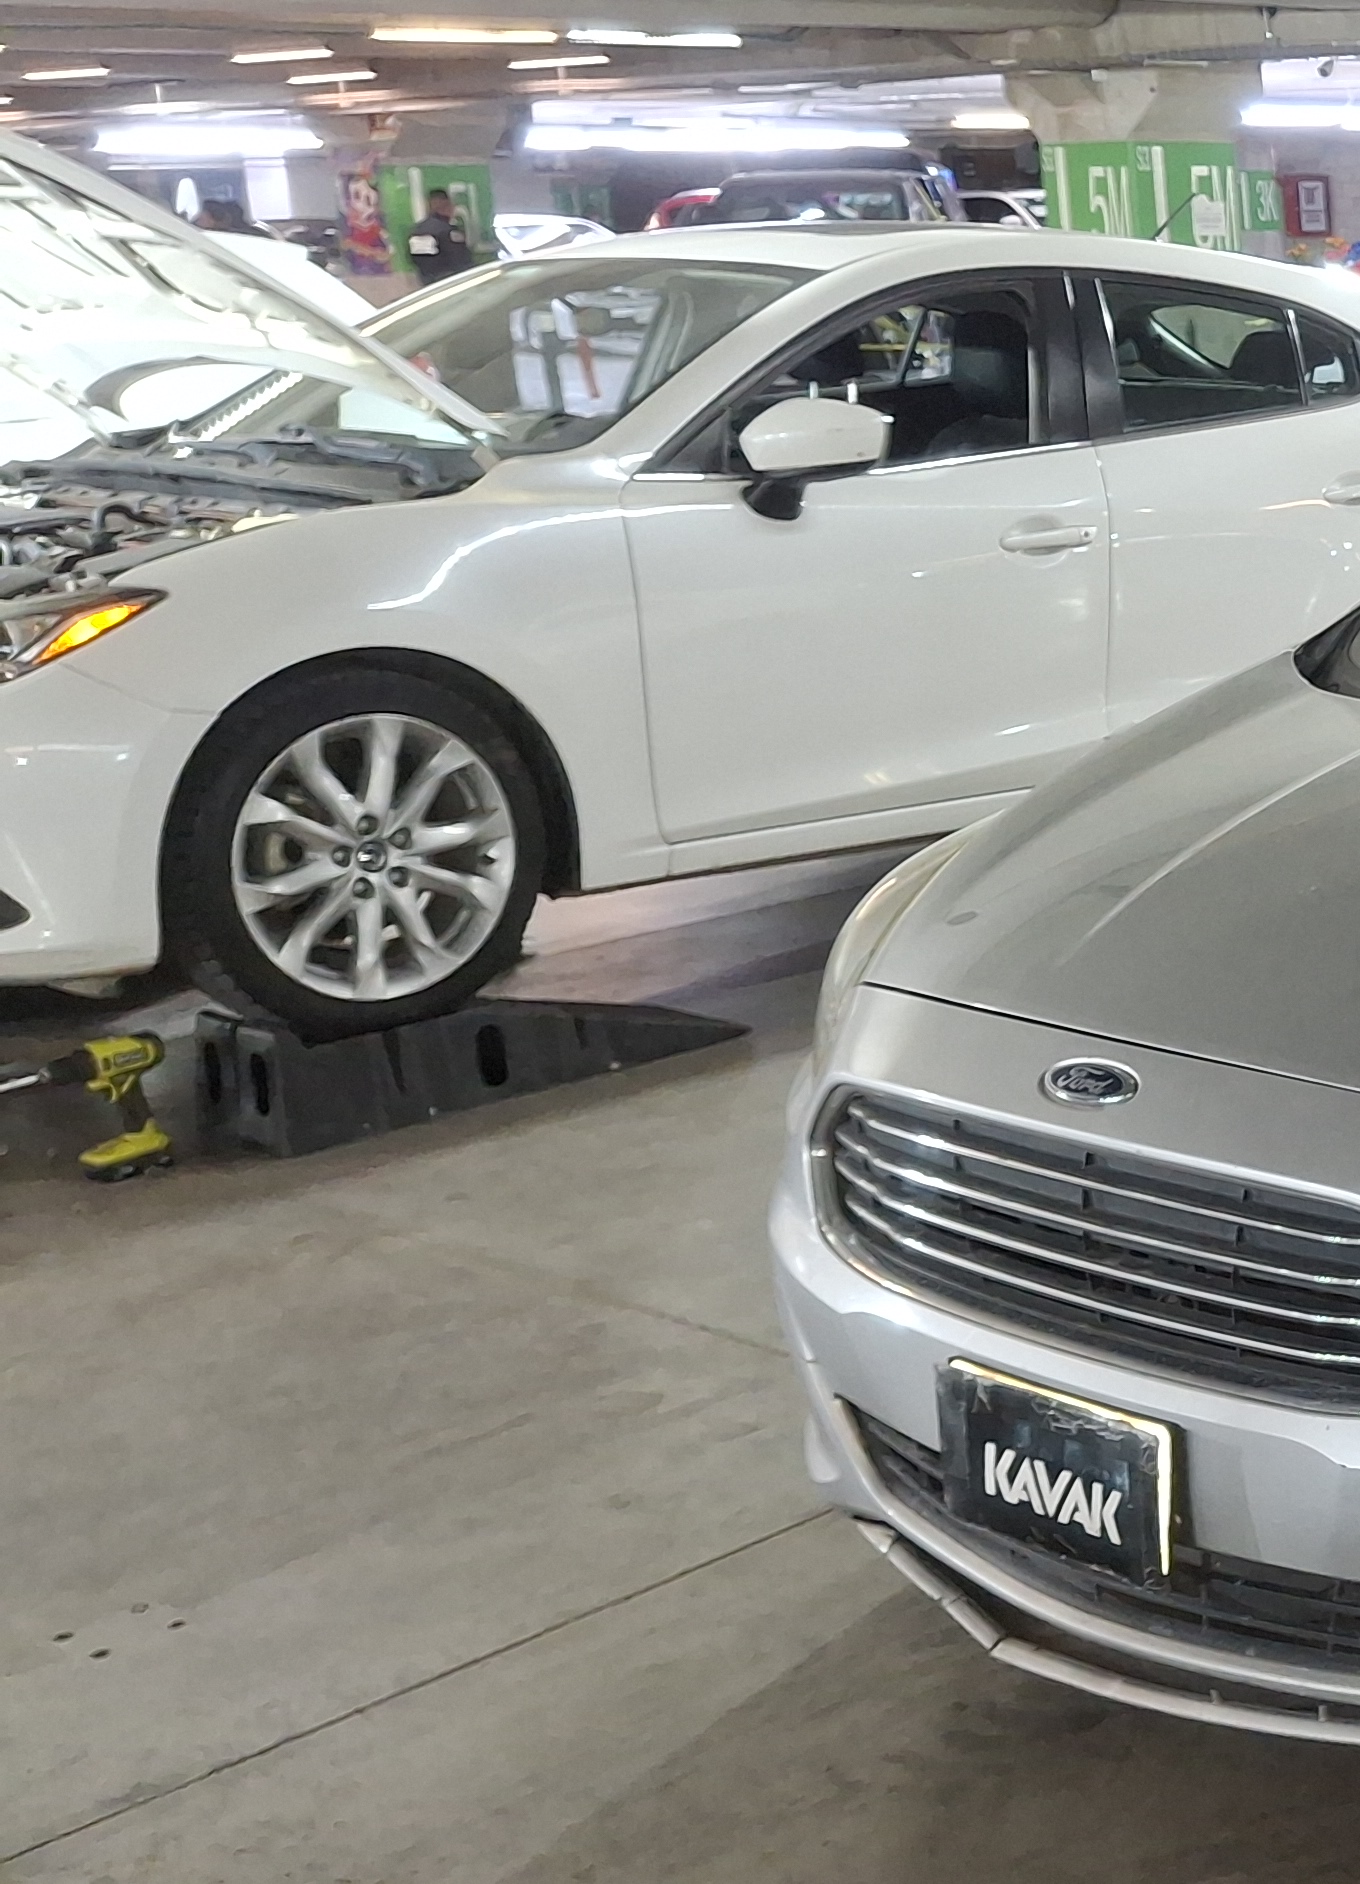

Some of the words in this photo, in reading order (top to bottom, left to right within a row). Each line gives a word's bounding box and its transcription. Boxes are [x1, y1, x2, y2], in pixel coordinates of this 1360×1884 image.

[1088, 165, 1133, 237] 5M
[1256, 179, 1280, 222] 3K
[1056, 1066, 1115, 1096] Ford
[984, 1441, 1123, 1547] KAVAK
